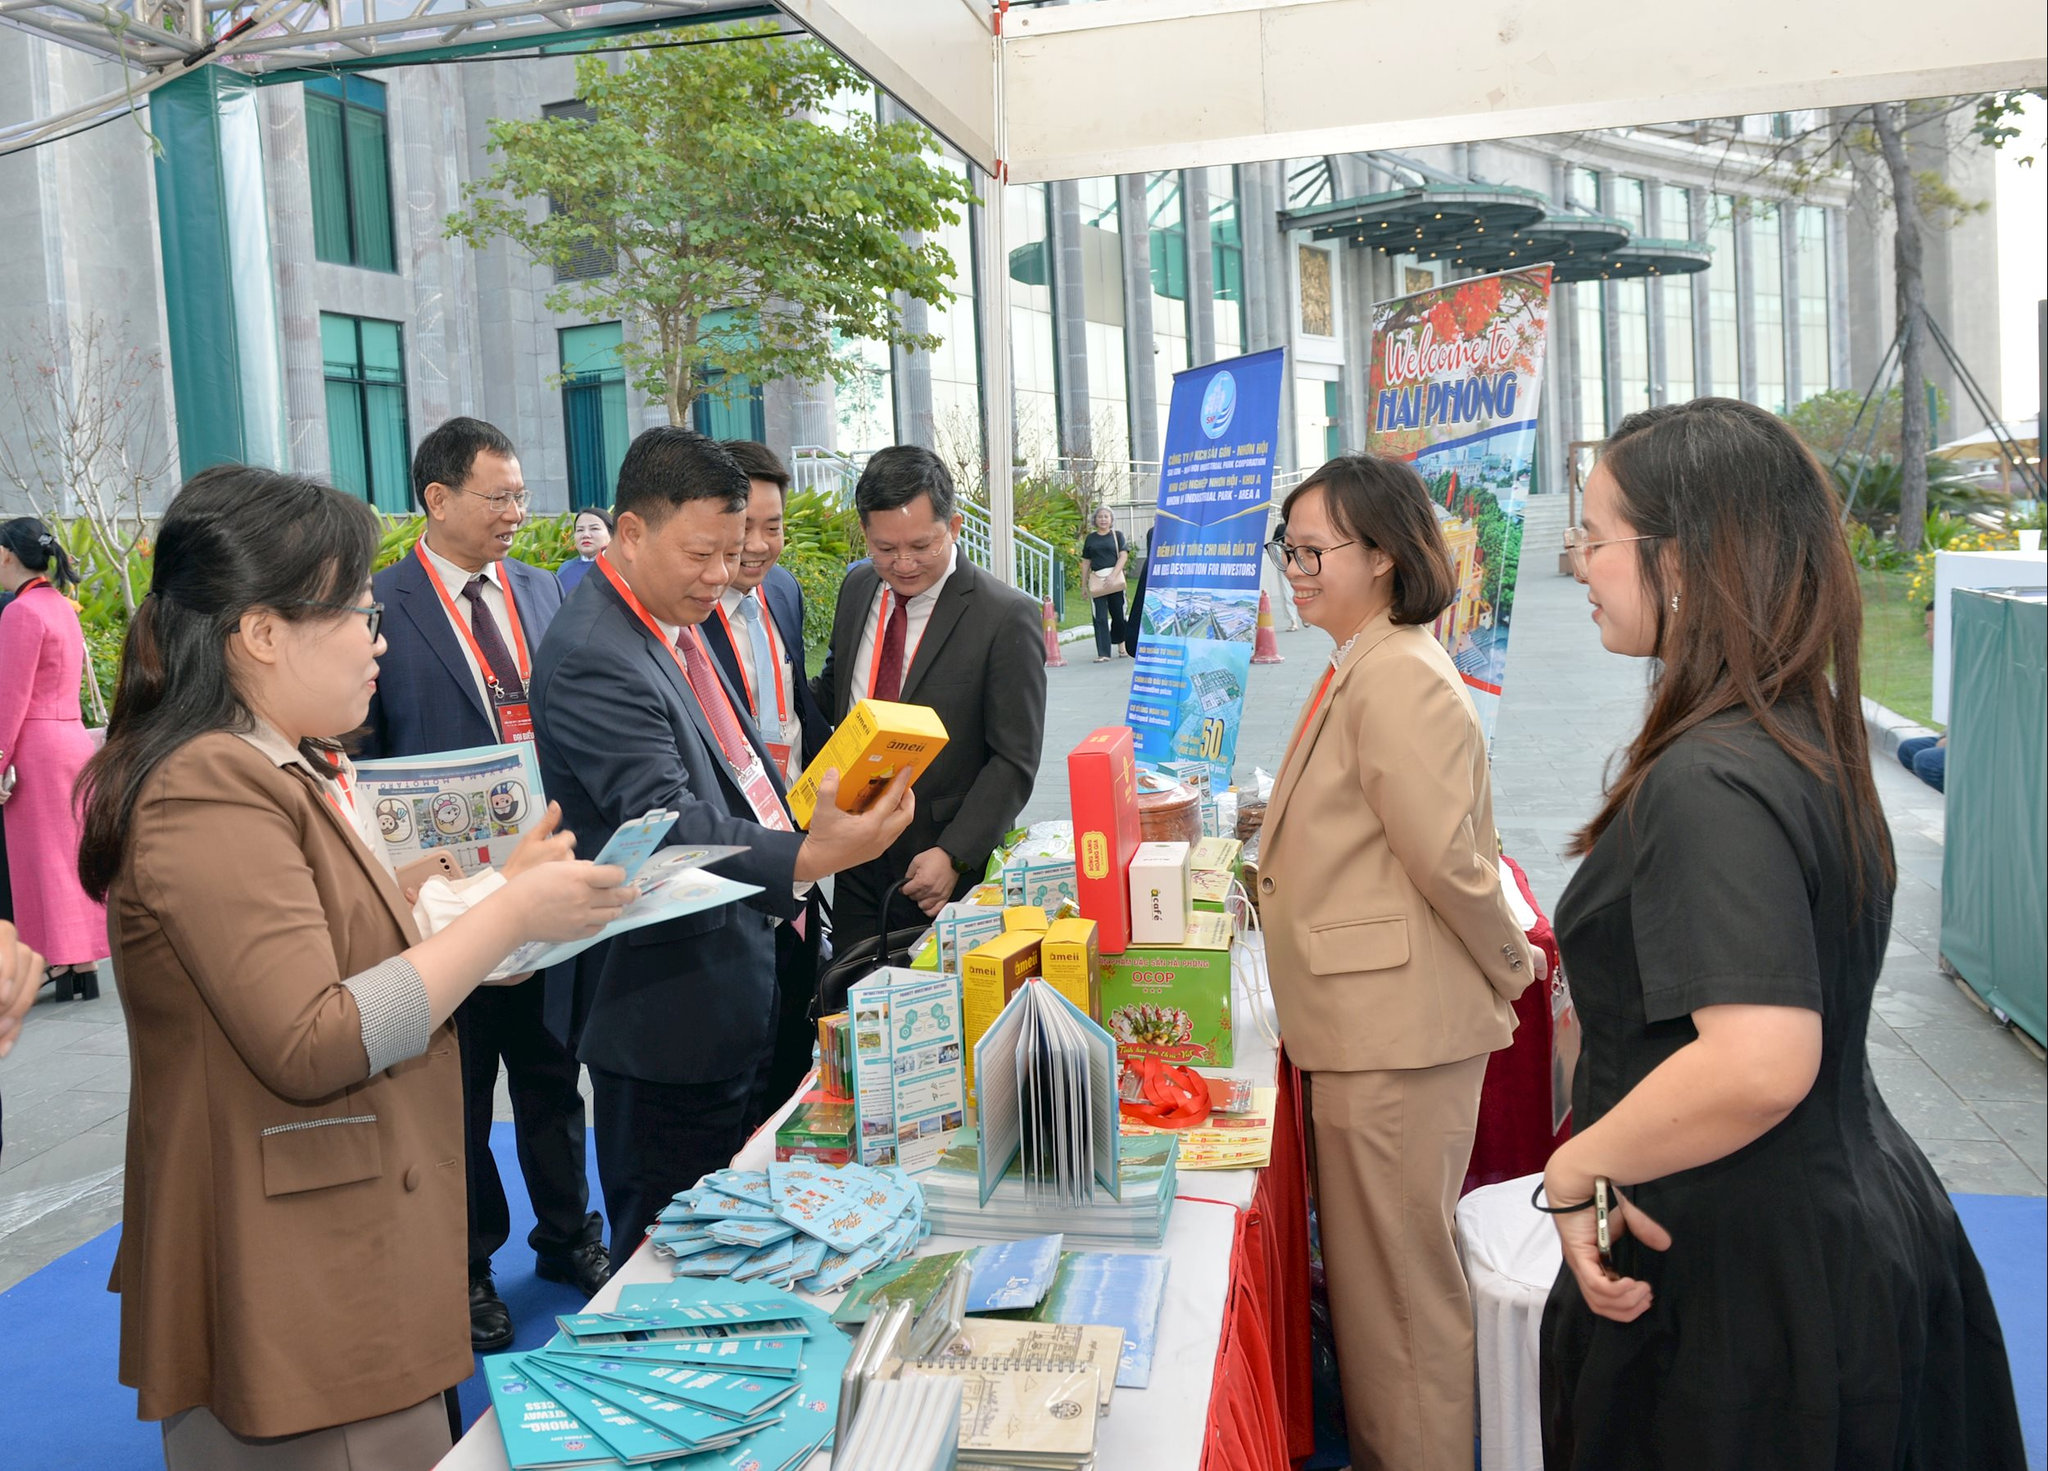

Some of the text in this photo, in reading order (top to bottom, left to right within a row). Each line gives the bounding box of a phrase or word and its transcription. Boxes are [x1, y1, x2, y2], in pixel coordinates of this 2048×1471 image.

[1386, 320, 1514, 385] Welcome to
[1376, 371, 1517, 432] HAI PHONG
[1207, 563, 1219, 575] FOR
[1220, 563, 1256, 576] INVESTORS
[1200, 717, 1225, 760] 50
[380, 777, 450, 790] MOMOTARO
[1014, 951, 1038, 975] ameii
[1050, 952, 1079, 961] ameii
[969, 966, 996, 976] ameii
[1132, 971, 1175, 984] OCOP
[525, 1401, 556, 1411] CESS
